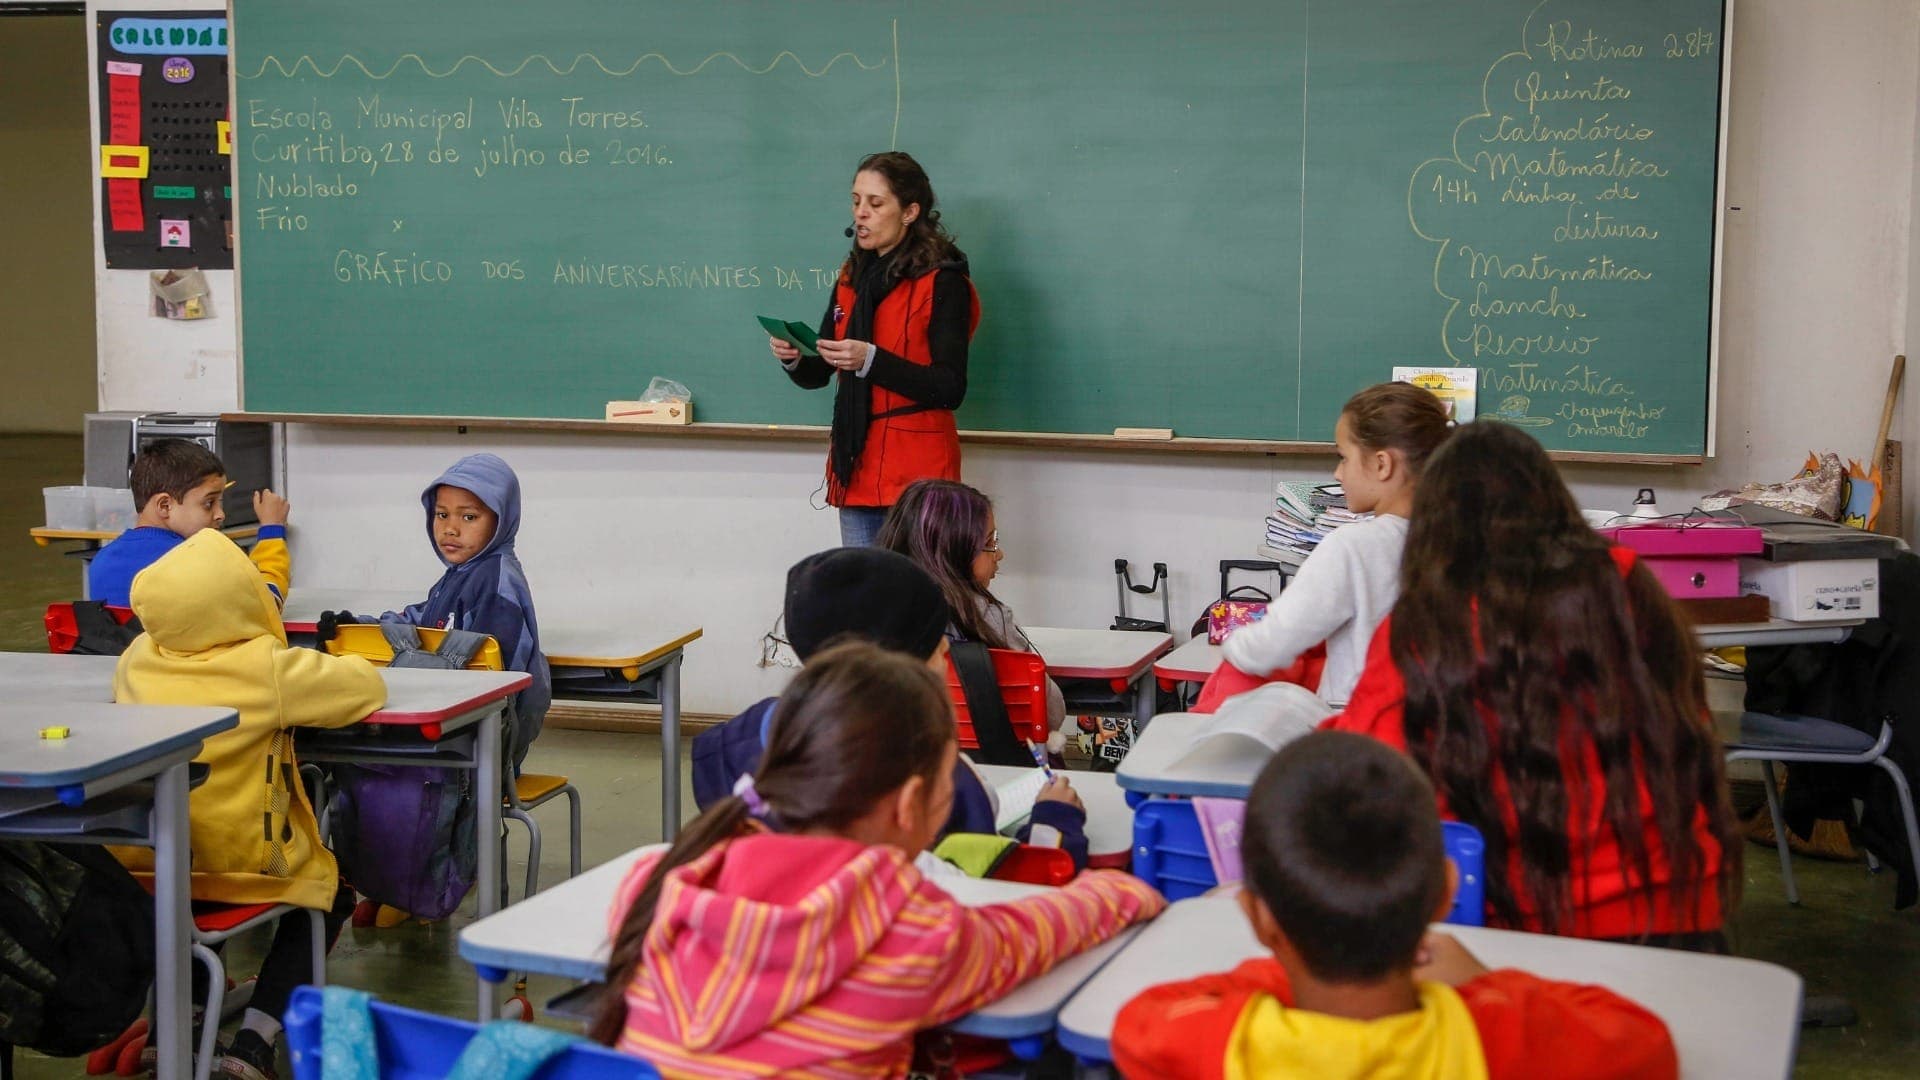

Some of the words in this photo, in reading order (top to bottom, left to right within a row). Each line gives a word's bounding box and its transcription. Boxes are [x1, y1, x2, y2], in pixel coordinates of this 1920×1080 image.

[1536, 19, 1644, 62] Rotina
[1514, 70, 1631, 115] Quinta
[249, 98, 333, 131] Escola
[356, 96, 474, 140] Municipal
[498, 97, 543, 129] Vila
[561, 97, 650, 129] Torres.
[1480, 112, 1656, 143] Calendário
[428, 137, 460, 164] de
[474, 134, 546, 178] julho
[558, 134, 591, 166] de
[1474, 148, 1671, 181] Matemática
[256, 171, 359, 201] Nublado
[1432, 174, 1478, 204] 14h
[1502, 176, 1577, 202] Linha
[1596, 182, 1640, 200] de
[256, 205, 309, 233] Frio
[481, 258, 527, 283] DOS
[553, 256, 761, 289] ANIVERSARIANTES
[773, 265, 803, 291] DA
[1459, 245, 1652, 281] Matemática
[1469, 281, 1587, 319] Lanche
